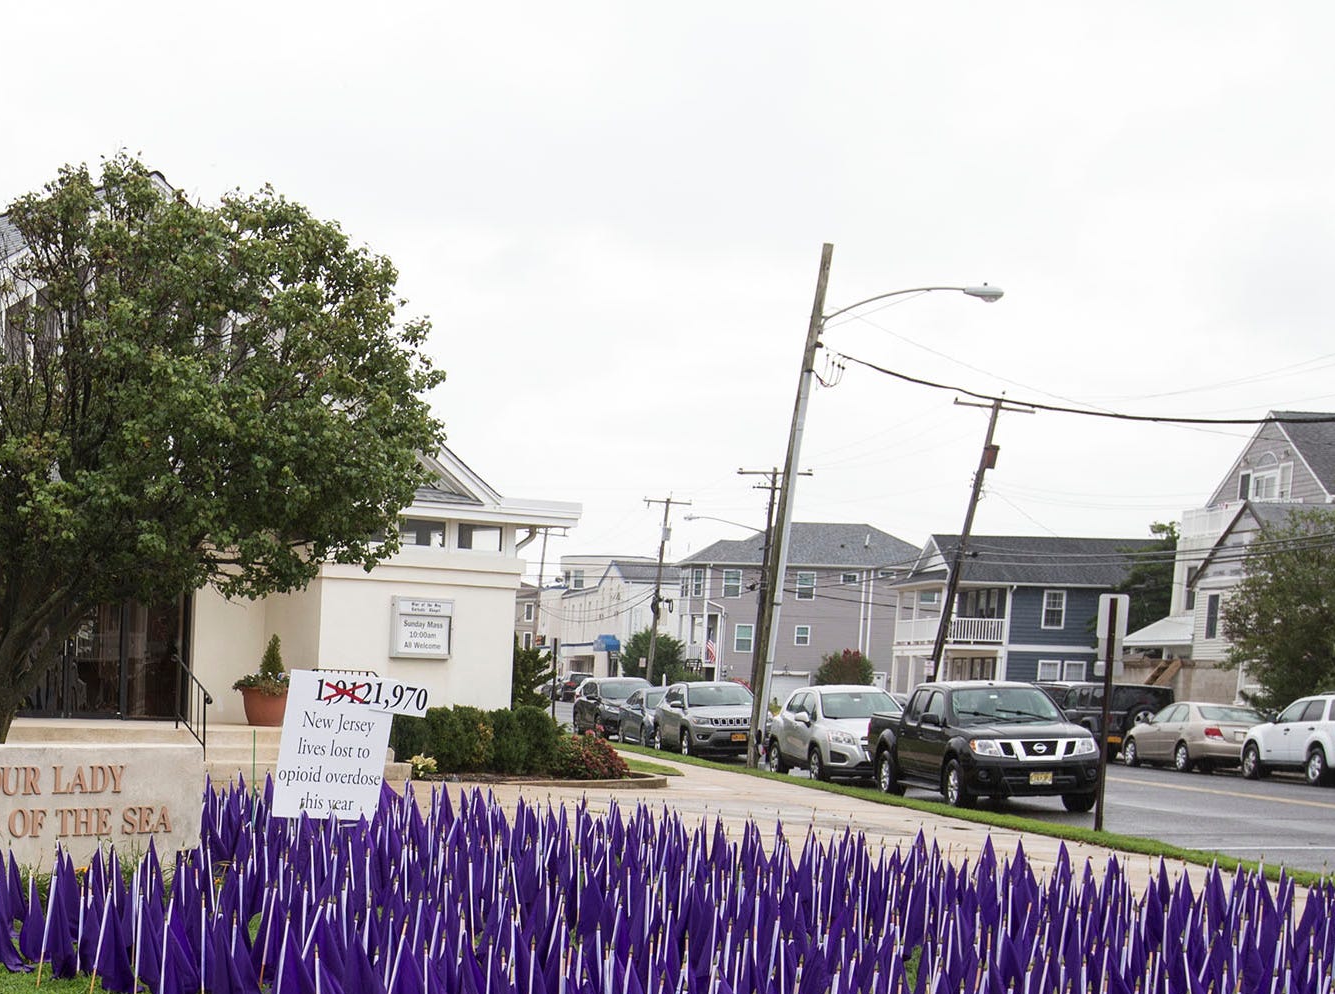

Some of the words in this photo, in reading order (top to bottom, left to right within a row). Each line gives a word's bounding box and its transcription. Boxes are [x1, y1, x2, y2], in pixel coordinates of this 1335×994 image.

[403, 619, 425, 629] Sunday
[427, 620, 443, 629] Mass
[409, 631, 437, 639] 10:00am
[414, 641, 441, 650] Welcome
[373, 682, 428, 711] 1,970
[302, 710, 334, 729] New
[335, 713, 375, 737] Jersey
[297, 737, 326, 756] lives
[330, 739, 353, 758] lost
[357, 748, 370, 759] to
[51, 764, 125, 795] LADY
[278, 765, 322, 786] opioid
[325, 768, 381, 786] overdose
[299, 791, 324, 810] this
[326, 799, 355, 815] year
[8, 808, 47, 838] OF
[55, 807, 113, 837] THE
[121, 805, 172, 835] SEA
